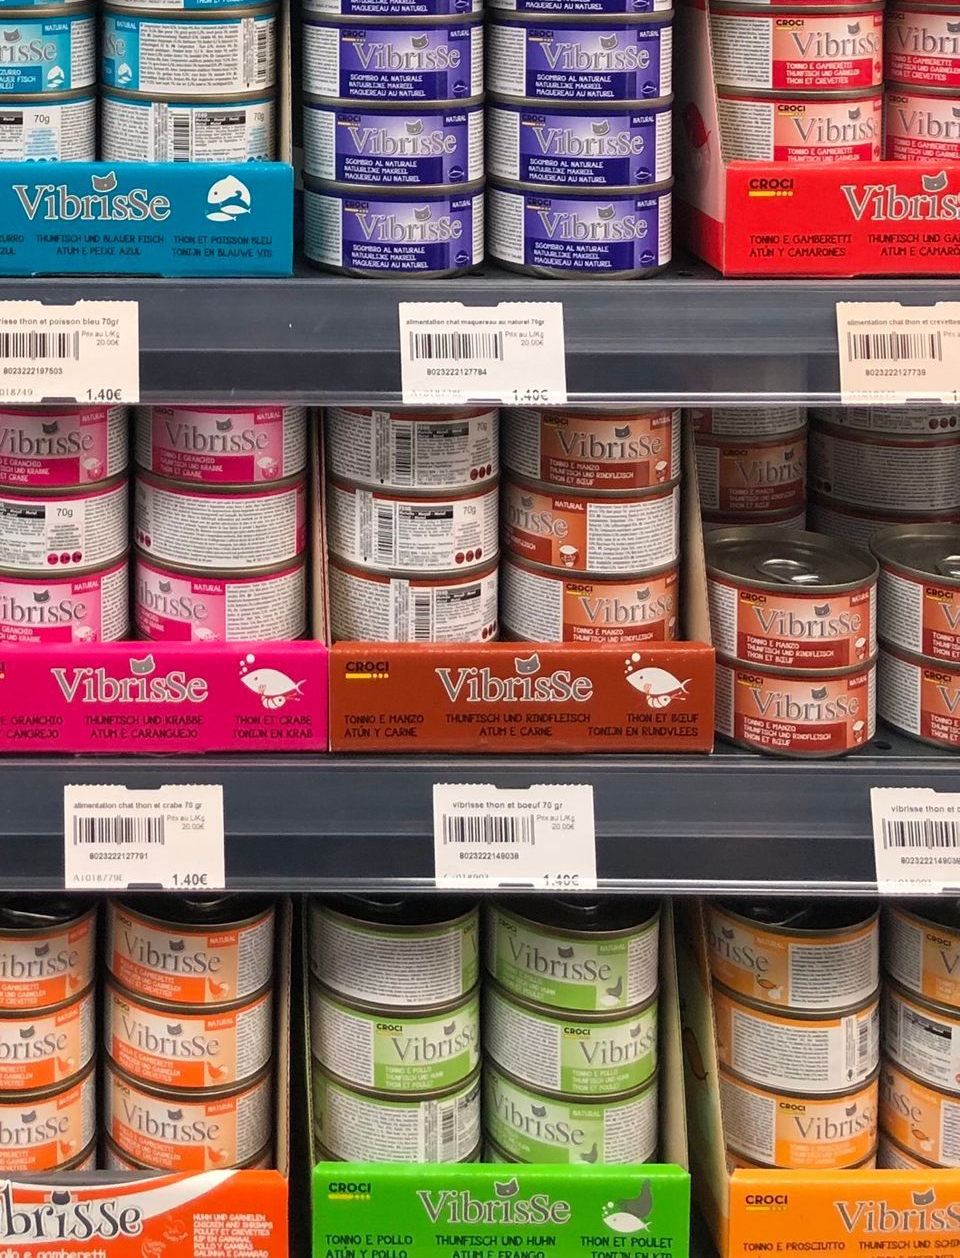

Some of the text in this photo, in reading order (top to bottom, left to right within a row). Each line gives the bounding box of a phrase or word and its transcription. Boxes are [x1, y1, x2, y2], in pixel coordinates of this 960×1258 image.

[749, 178, 793, 190] CROCI
[750, 234, 852, 245] TONNO E GAMBERETTI
[86, 389, 122, 400] 1.40€
[56, 507, 73, 518] 70g
[346, 661, 389, 673] CROCI
[344, 714, 424, 724] TONNO E MANZO
[172, 874, 208, 885] 1.40€
[328, 1182, 371, 1193] CROCI
[745, 1195, 788, 1205] CROCI
[326, 1234, 413, 1245] TONNO E POLLO
[743, 1241, 845, 1252] TONNO E PROSCIUTTO
